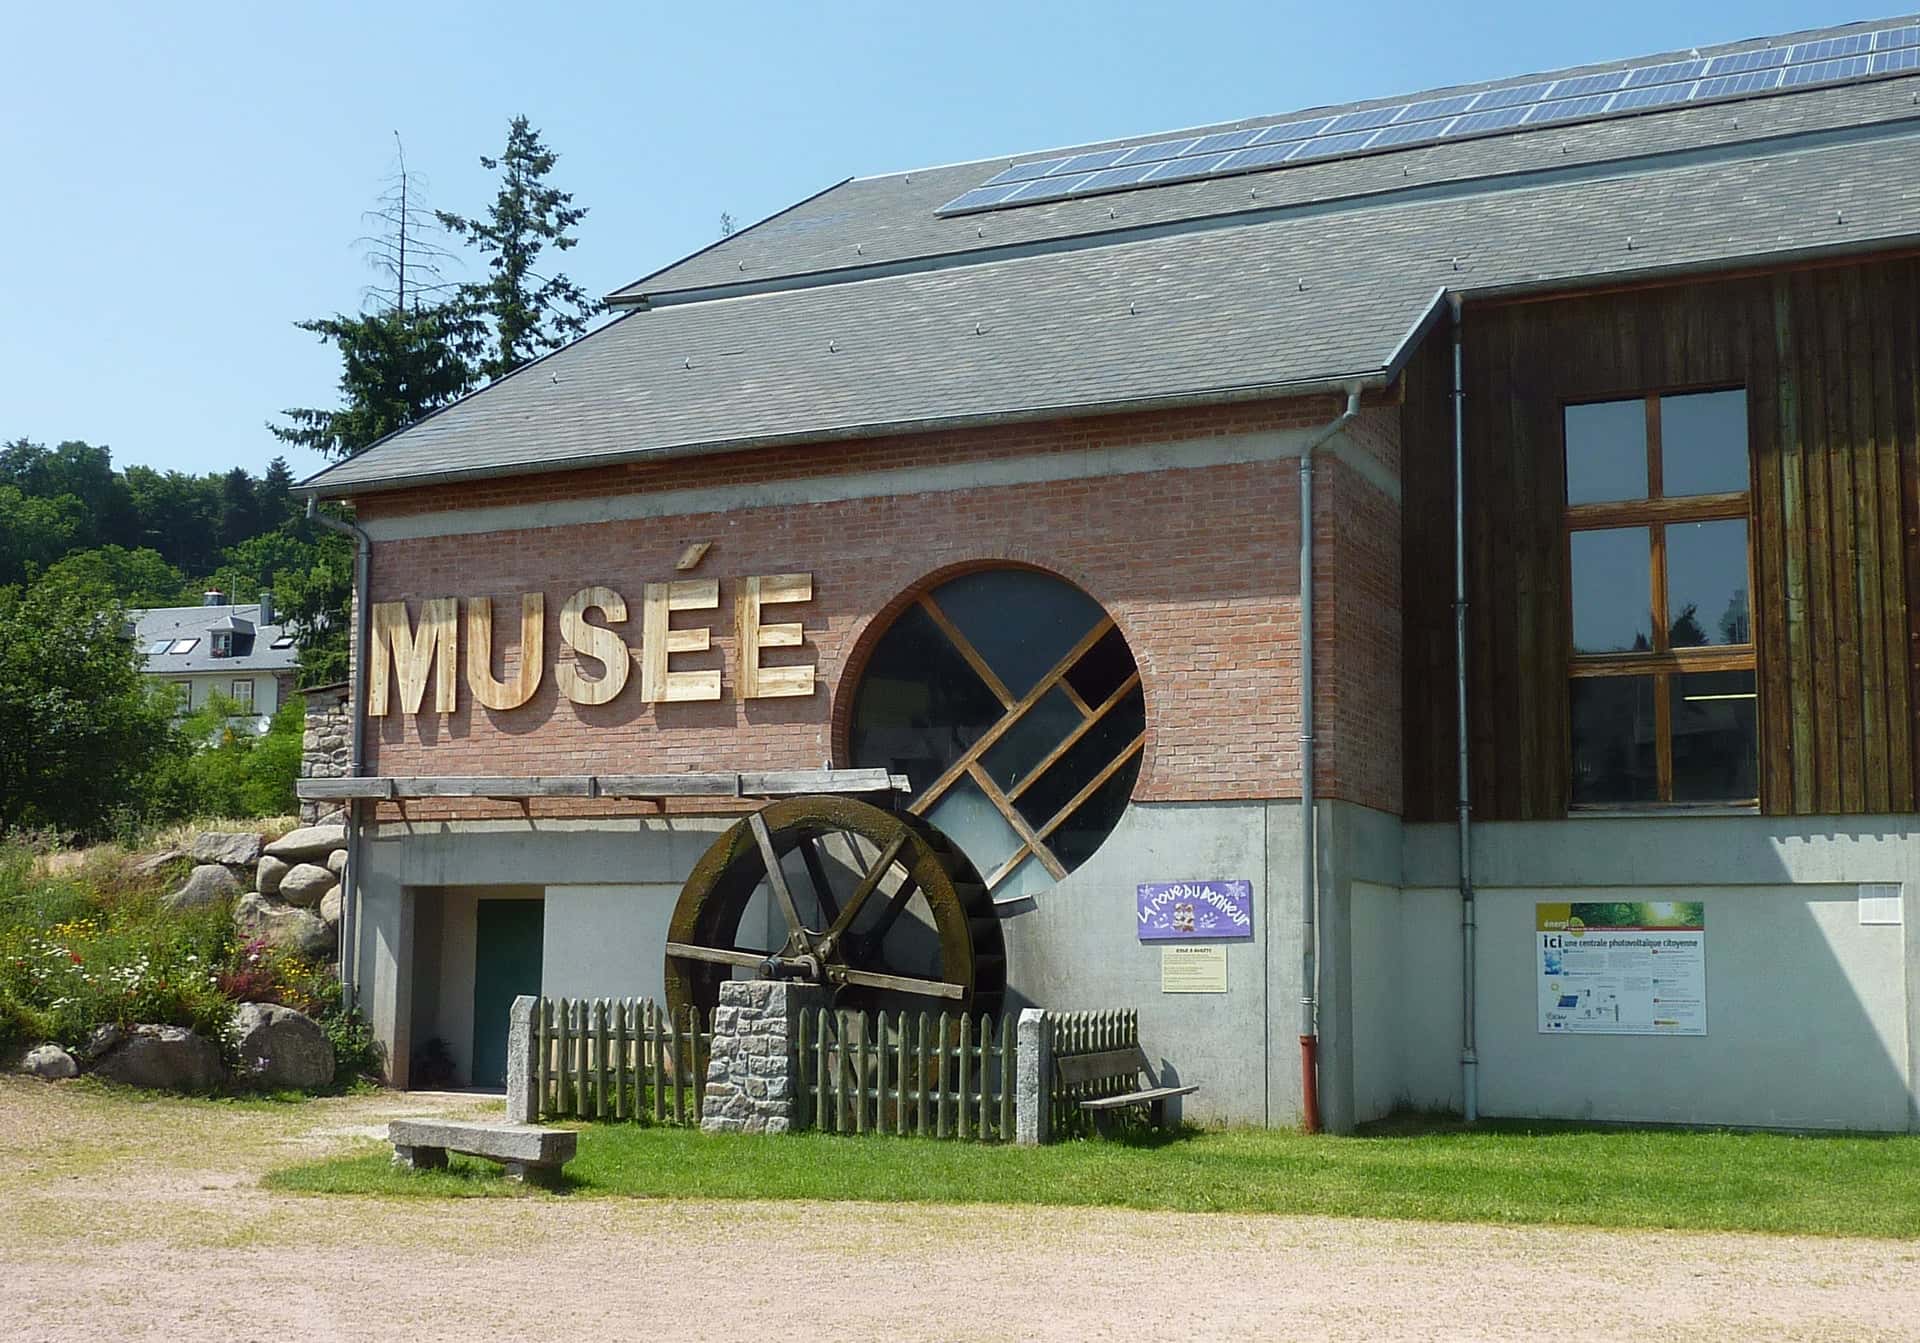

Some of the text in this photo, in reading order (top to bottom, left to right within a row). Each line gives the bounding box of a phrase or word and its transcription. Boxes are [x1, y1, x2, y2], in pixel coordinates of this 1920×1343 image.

[368, 542, 815, 716] MUSÉE
[1137, 906, 1157, 924] LA
[1183, 884, 1200, 899] DU
[1544, 935, 1563, 949] ici
[1564, 939, 1578, 947] une
[1579, 937, 1608, 947] centrale
[1663, 937, 1698, 949] citoyenne
